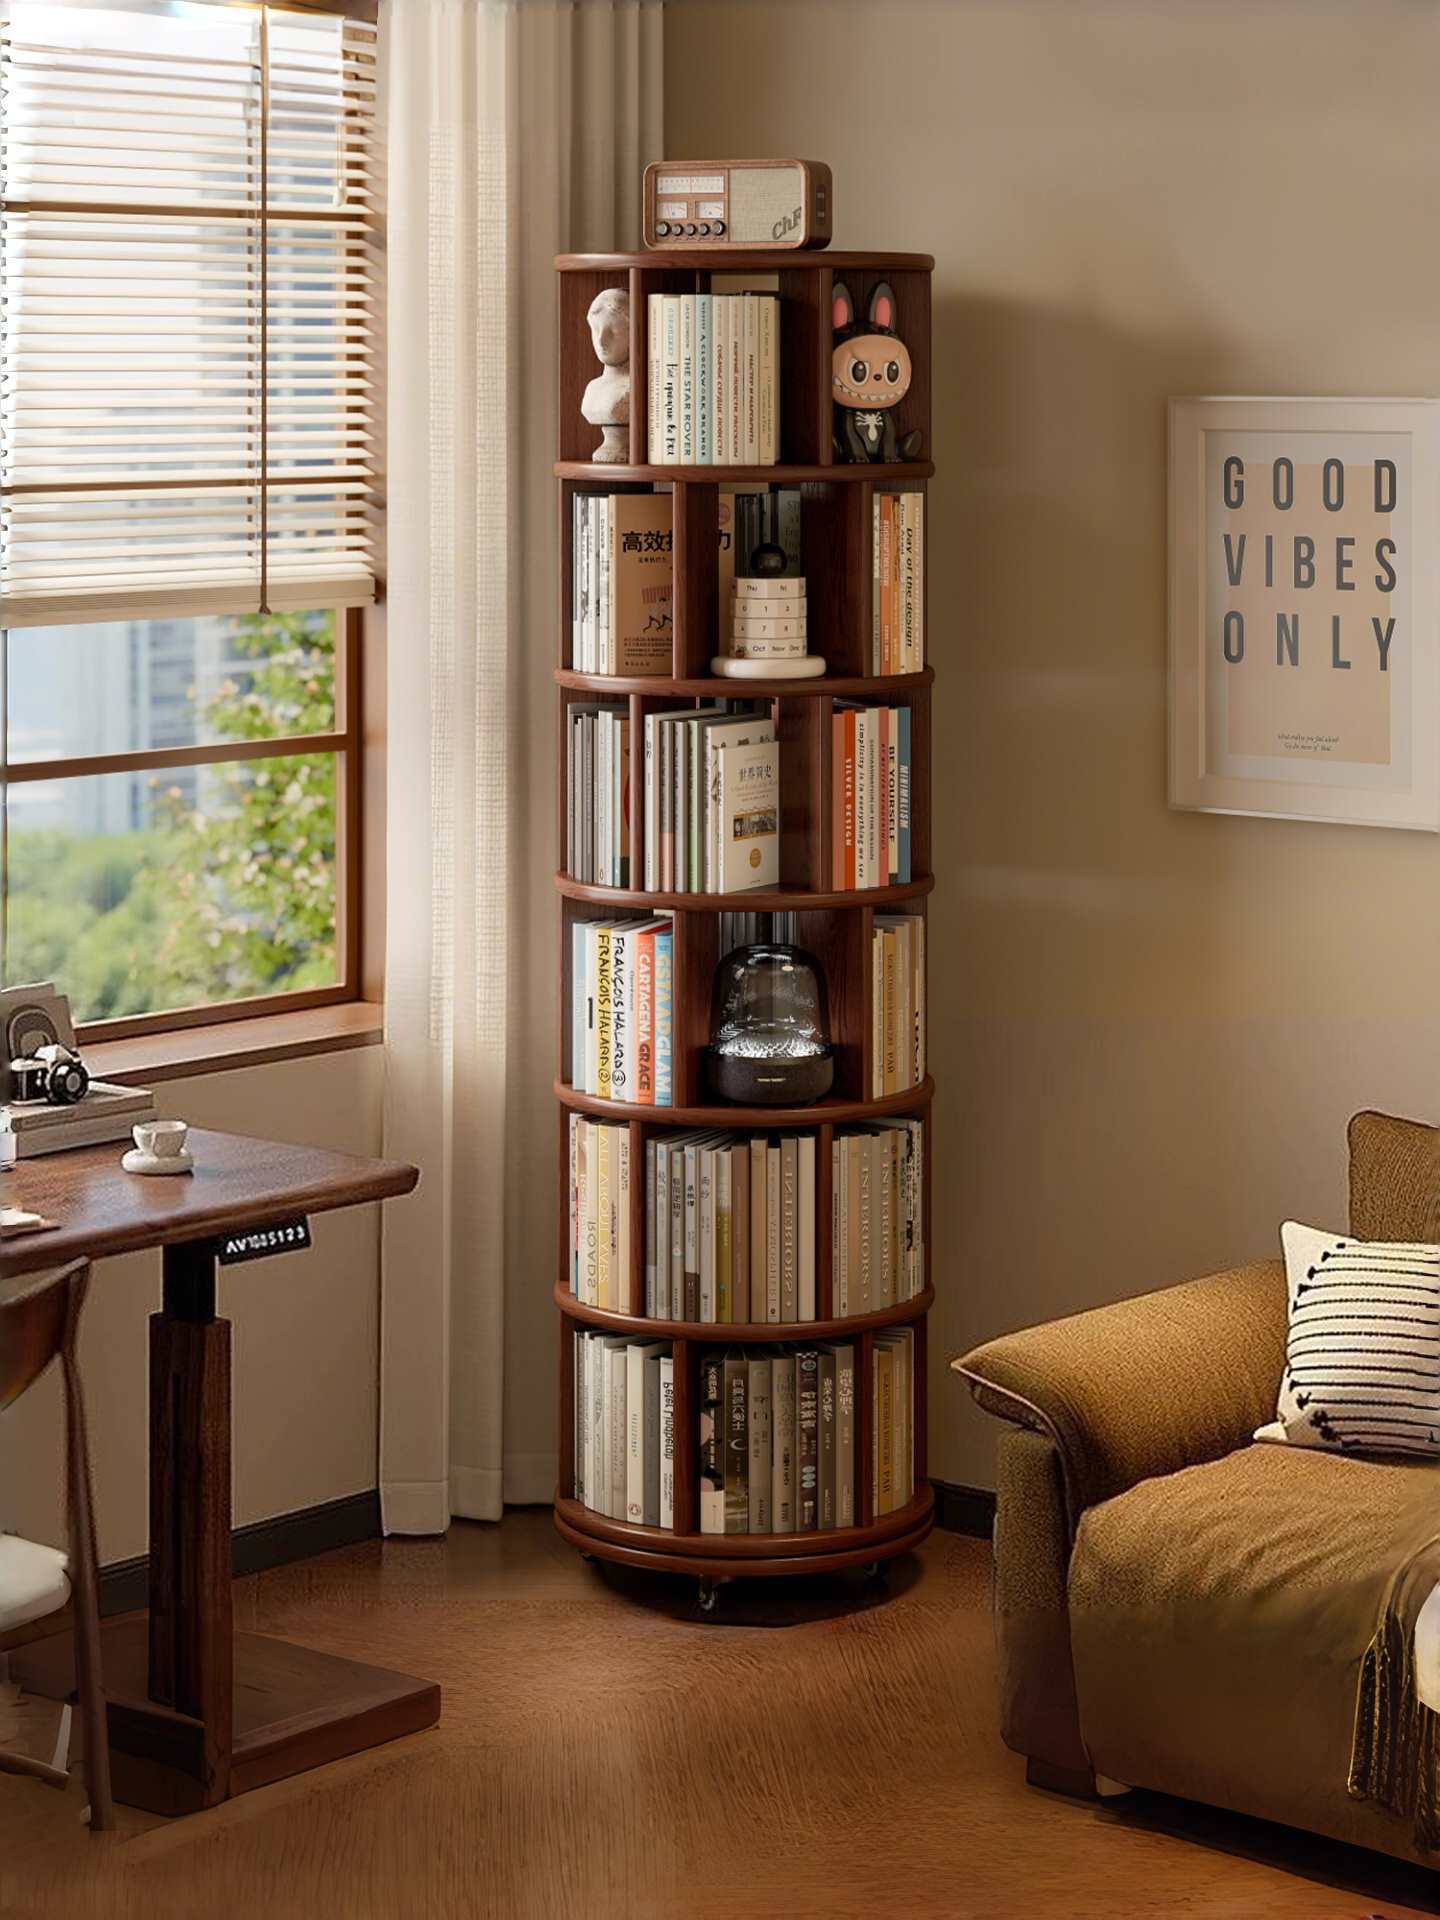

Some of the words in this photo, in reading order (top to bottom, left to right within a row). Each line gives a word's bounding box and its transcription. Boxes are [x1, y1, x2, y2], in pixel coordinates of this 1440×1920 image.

[1223, 455, 1397, 513] GOOD
[907, 558, 913, 571] of
[1223, 533, 1397, 593] VIBES
[1223, 610, 1396, 672] ONLY
[889, 746, 895, 764] BE
[899, 765, 909, 829] MINIMALISM
[598, 934, 610, 1005] FRANÇOIS
[611, 936, 625, 1007] FRANÇOIS
[639, 954, 651, 1043] CARTAGENA
[598, 1009, 611, 1067] HALARD
[613, 1011, 625, 1069] HALARD
[638, 1044, 650, 1090] GRACE
[656, 1037, 672, 1092] GLAM
[600, 1173, 608, 1231] ABOUT
[861, 1167, 869, 1284] INTERIORS
[600, 1240, 608, 1283] YVES
